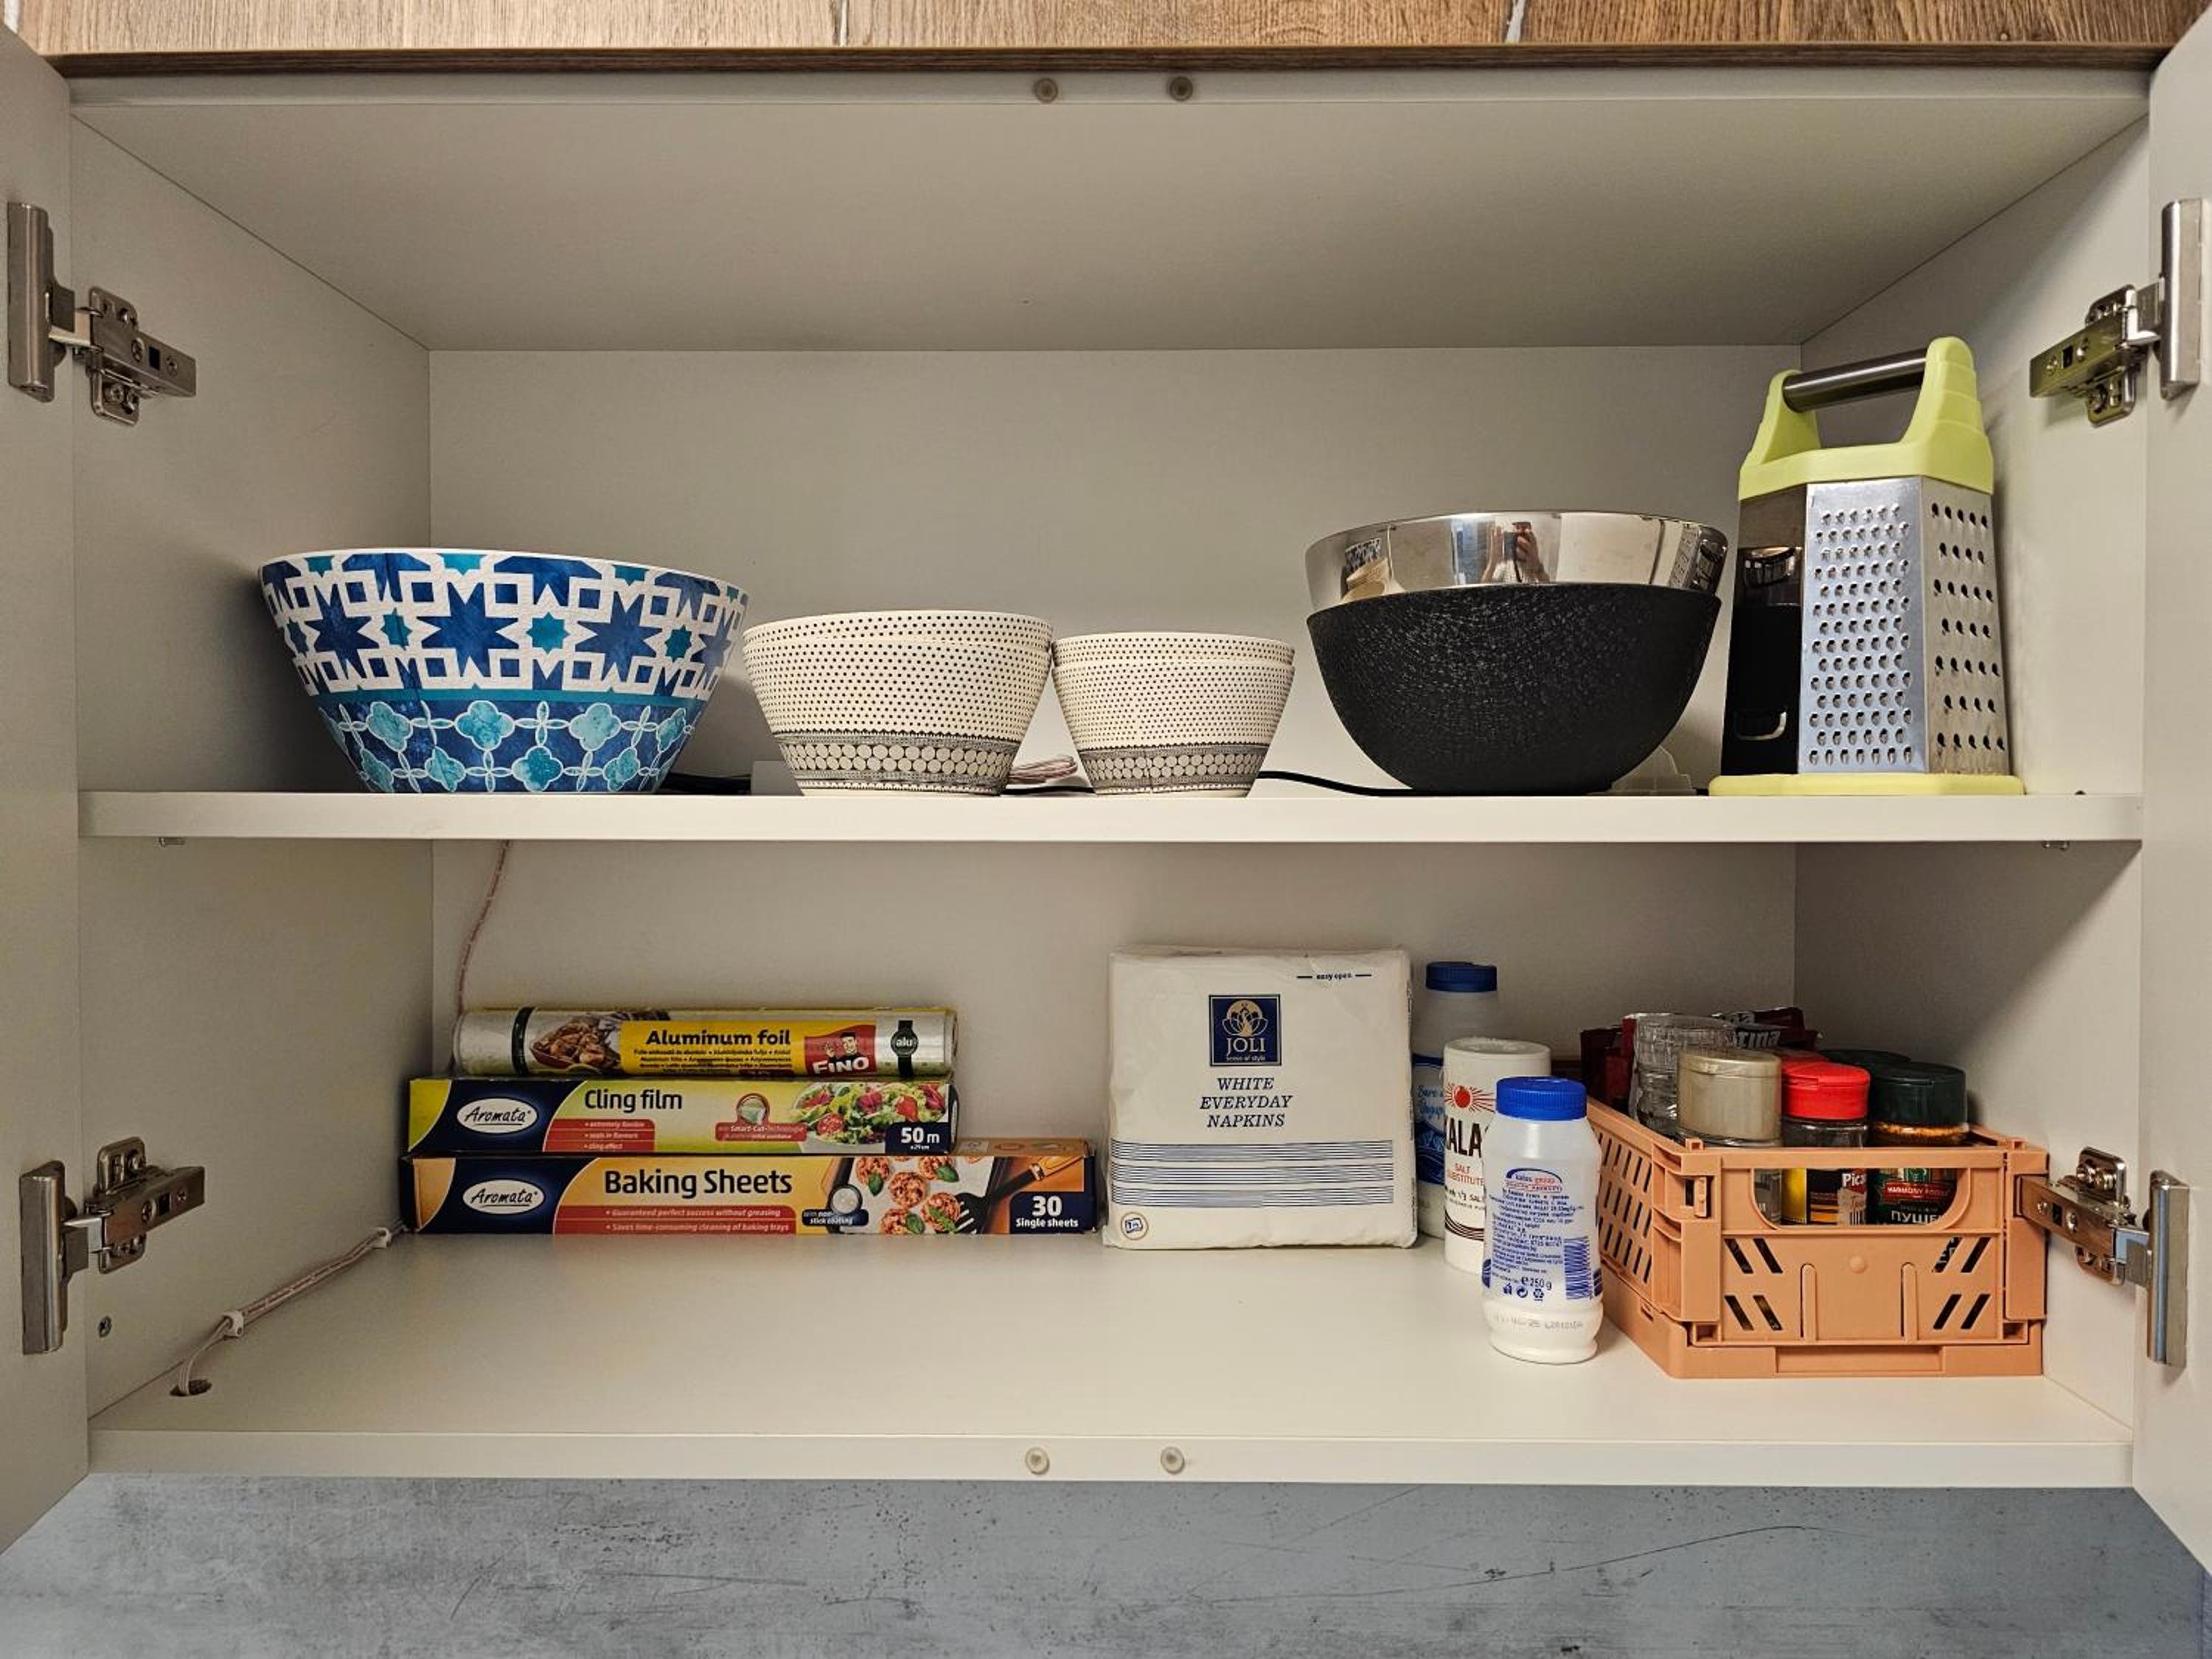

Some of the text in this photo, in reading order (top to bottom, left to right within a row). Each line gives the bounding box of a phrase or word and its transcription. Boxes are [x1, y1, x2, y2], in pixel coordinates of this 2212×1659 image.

[646, 1028, 791, 1045] Aluminum foil
[896, 1037, 913, 1047] alu
[1226, 1037, 1266, 1057] JOLI
[813, 1057, 870, 1075] FINO
[1217, 1077, 1275, 1091] WHITE
[585, 1089, 682, 1113] Cling film
[1200, 1095, 1294, 1109] EVERYDAY
[465, 1105, 526, 1122] Aromata
[1207, 1113, 1285, 1127] NAPKINS
[900, 1127, 940, 1144] 50 m
[1444, 1114, 1489, 1158] ALA
[605, 1169, 793, 1199] Baking Sheets
[470, 1186, 533, 1203] Aromata
[746, 1209, 781, 1217] greasing
[1032, 1195, 1062, 1217] 30
[1015, 1218, 1079, 1228] Single sheets
[1891, 1210, 1941, 1224] ПУШЕ
[742, 1223, 768, 1232] baking
